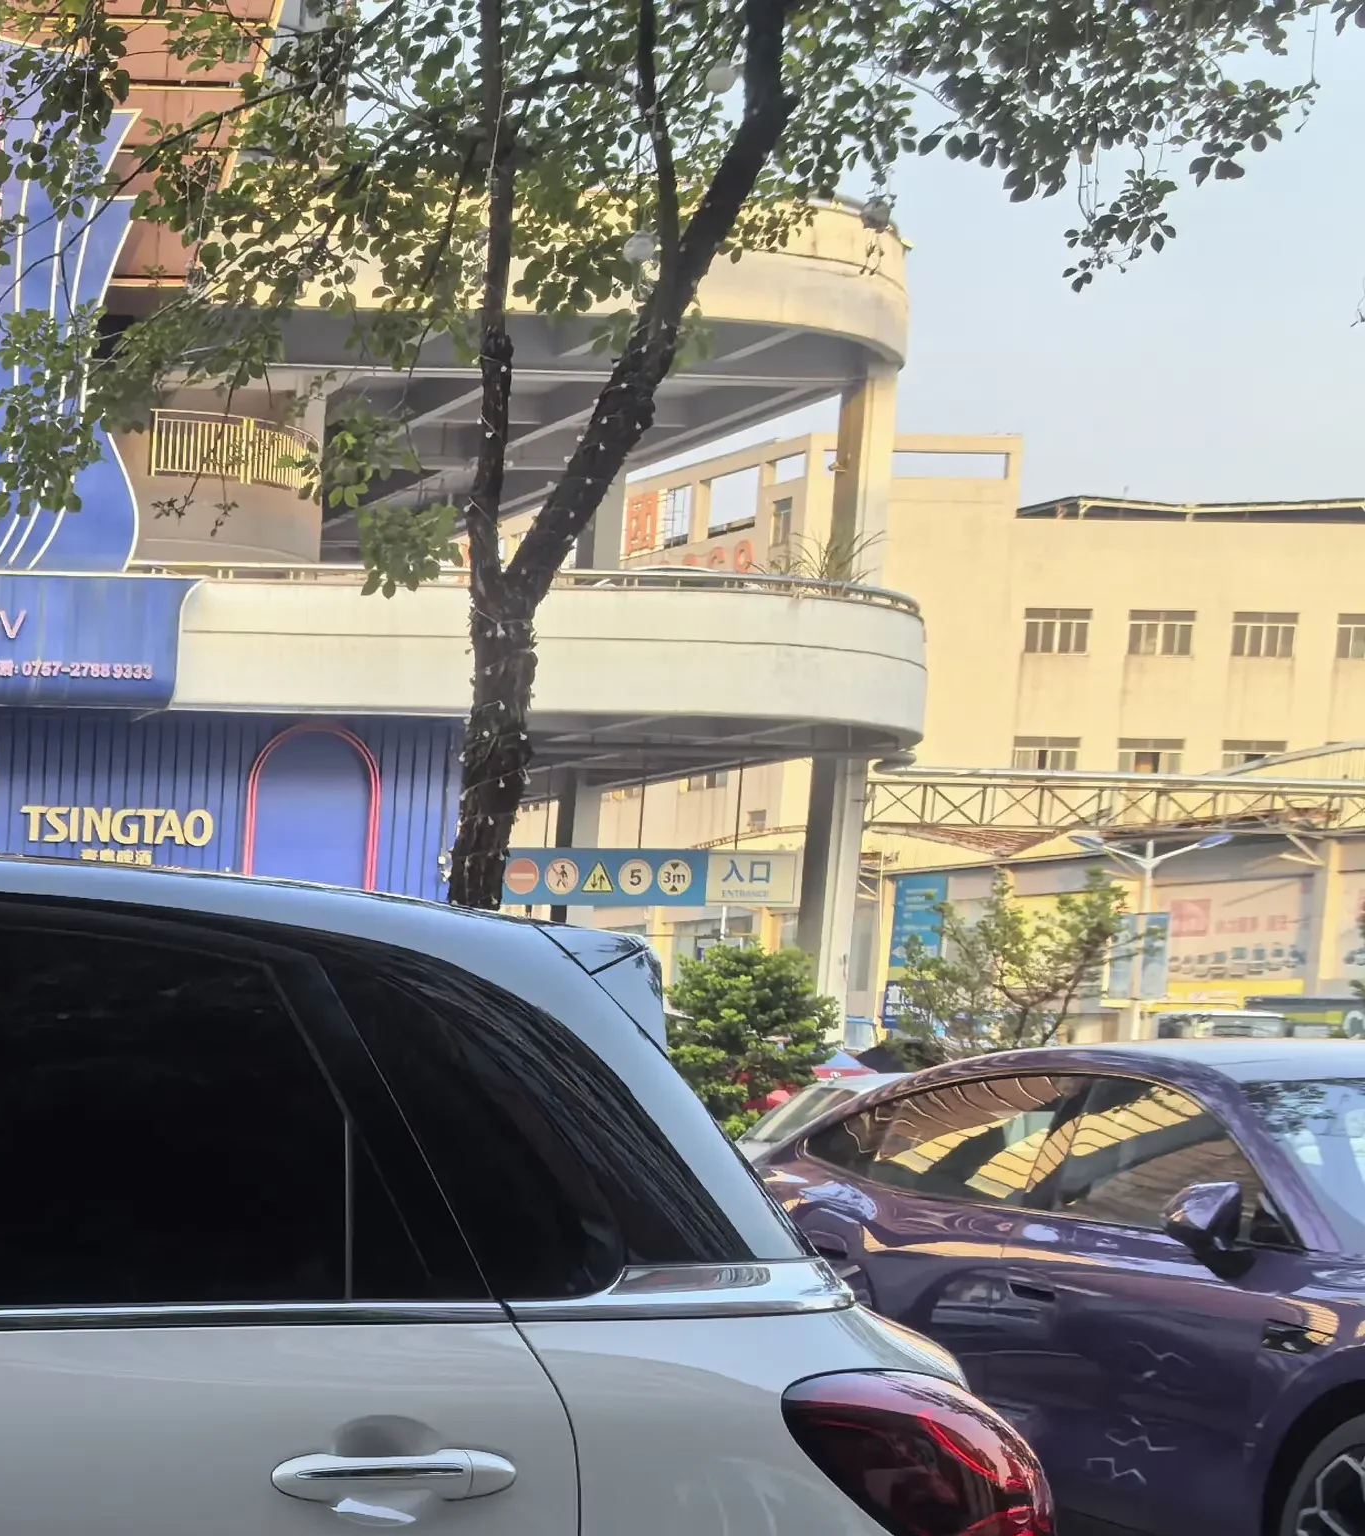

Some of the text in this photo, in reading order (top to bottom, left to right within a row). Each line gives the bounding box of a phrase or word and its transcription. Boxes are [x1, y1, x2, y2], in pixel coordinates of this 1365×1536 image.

[20, 805, 214, 847] TSINGTAO
[629, 868, 686, 886] 5 3m
[722, 859, 771, 883] 入口
[721, 889, 771, 898] ENTRANCE
